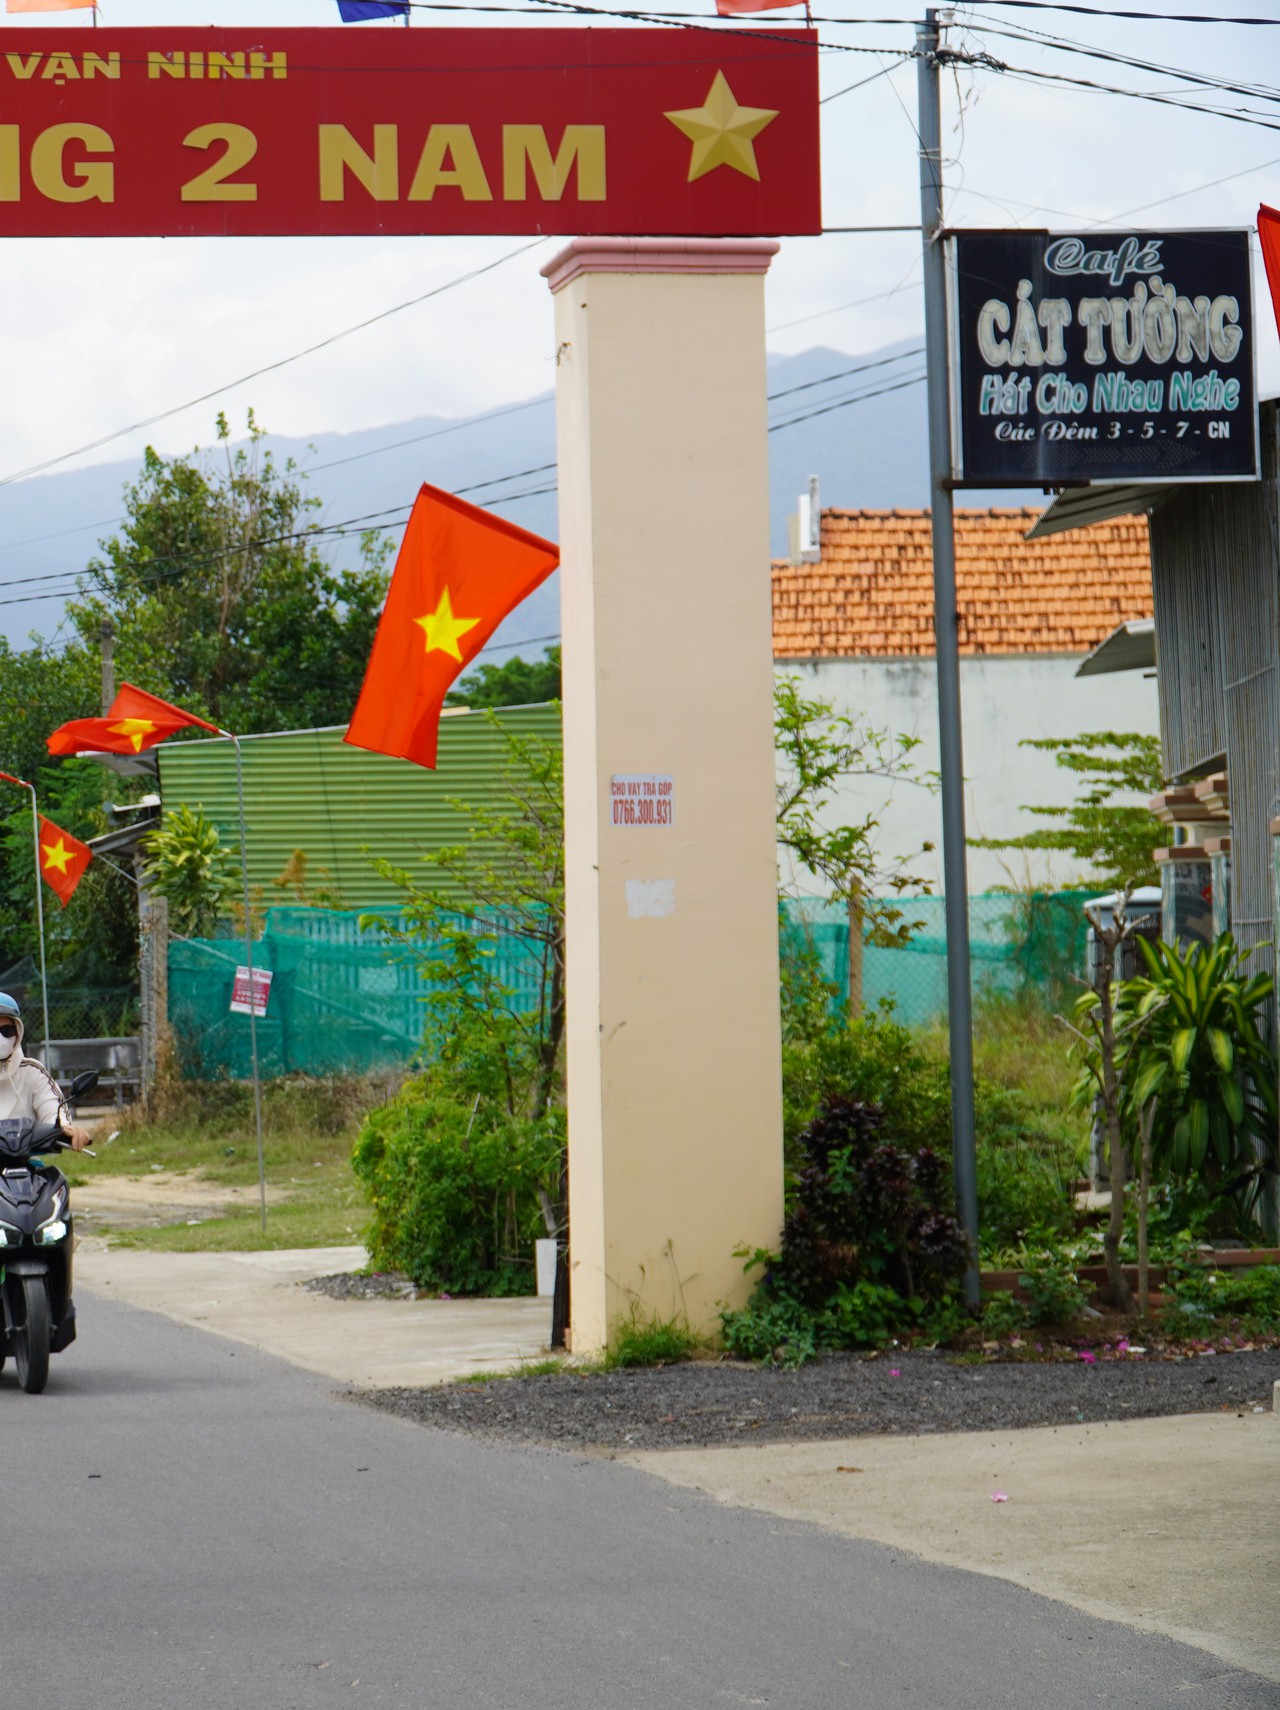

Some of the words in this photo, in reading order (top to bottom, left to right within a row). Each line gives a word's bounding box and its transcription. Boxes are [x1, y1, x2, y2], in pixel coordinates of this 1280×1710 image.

[5, 51, 121, 86] VẠN
[147, 50, 288, 79] NINH
[180, 122, 259, 202] 2
[318, 123, 608, 202] NAM
[1043, 236, 1165, 287] Café
[977, 278, 1073, 368] CÁT
[1077, 274, 1244, 365] TƯỜNG
[978, 371, 1033, 416] Hát
[1035, 371, 1089, 415] Cho
[1091, 370, 1165, 414] Nhau
[1168, 369, 1241, 413] Nghe
[994, 420, 1036, 442] Các
[1041, 419, 1100, 441] Đêm
[1107, 421, 1121, 439] 3
[1140, 421, 1155, 439] 5
[1175, 421, 1190, 439] 7
[1207, 421, 1230, 439] CN
[611, 782, 626, 796] CHO
[627, 782, 641, 796] VAY
[613, 799, 672, 824] 0766.300.931
